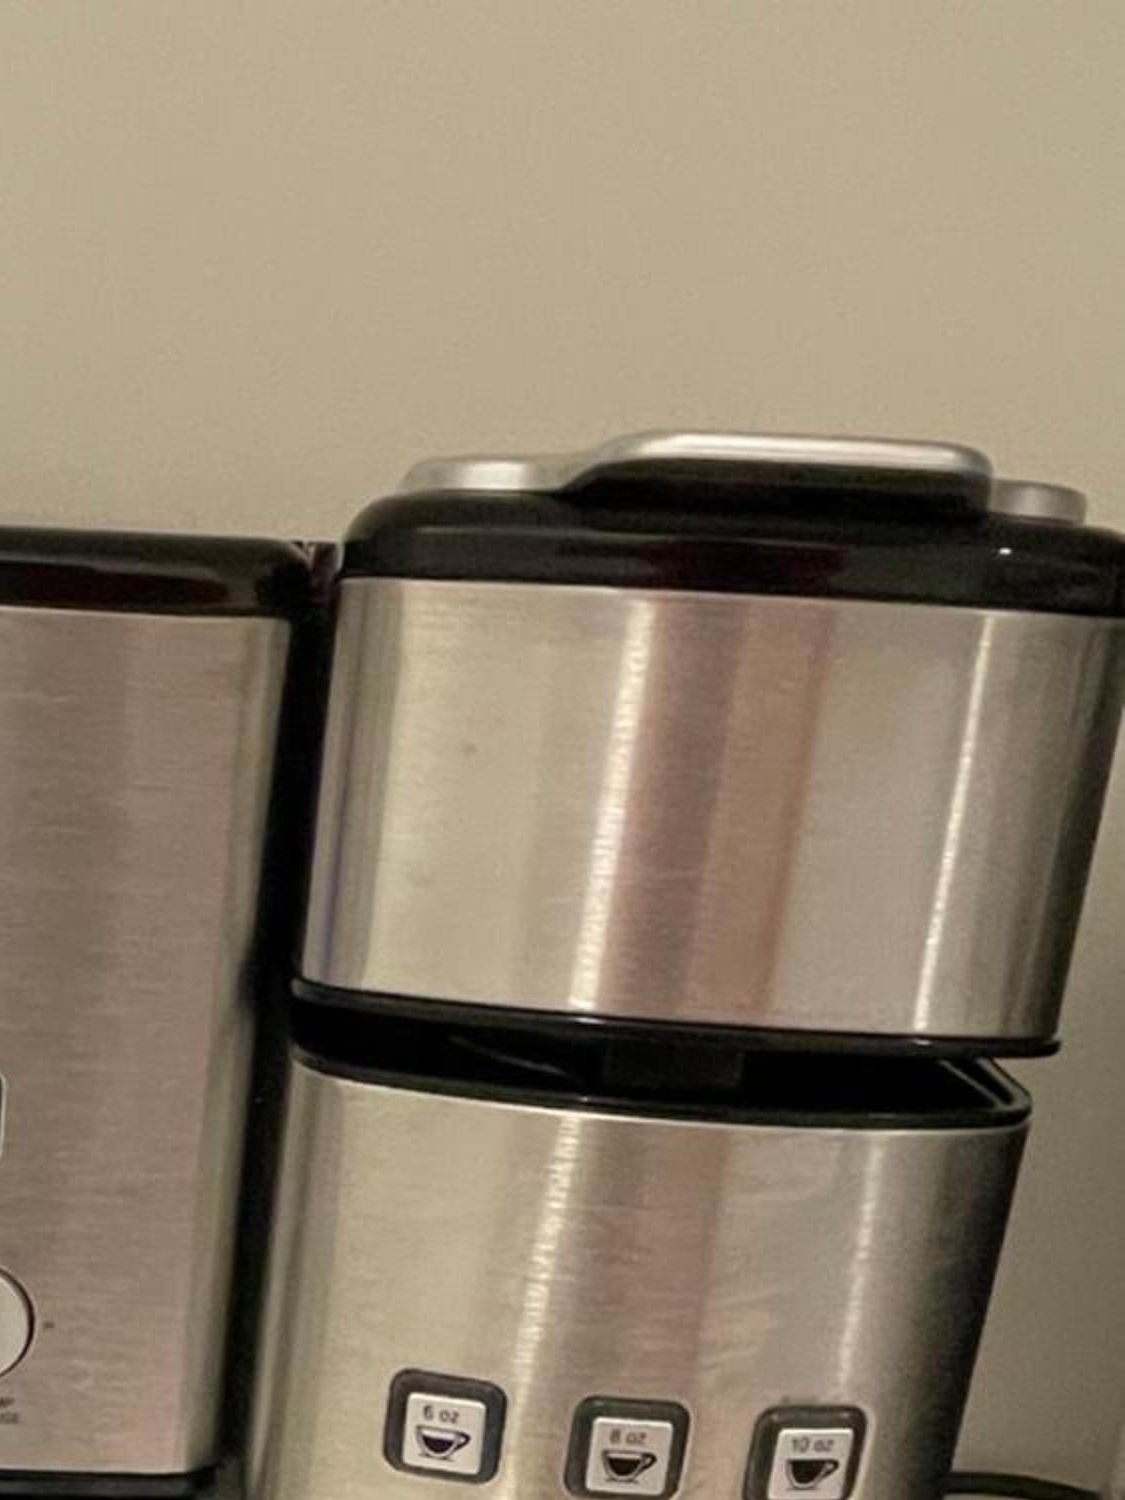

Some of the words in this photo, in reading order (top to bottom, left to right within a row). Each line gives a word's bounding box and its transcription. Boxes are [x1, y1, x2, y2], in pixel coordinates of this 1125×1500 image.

[422, 1404, 436, 1421] 6
[438, 1409, 460, 1424] oz
[609, 1428, 623, 1445] 8
[625, 1431, 647, 1447] oz
[791, 1436, 811, 1453] 10
[814, 1437, 836, 1453] oz
